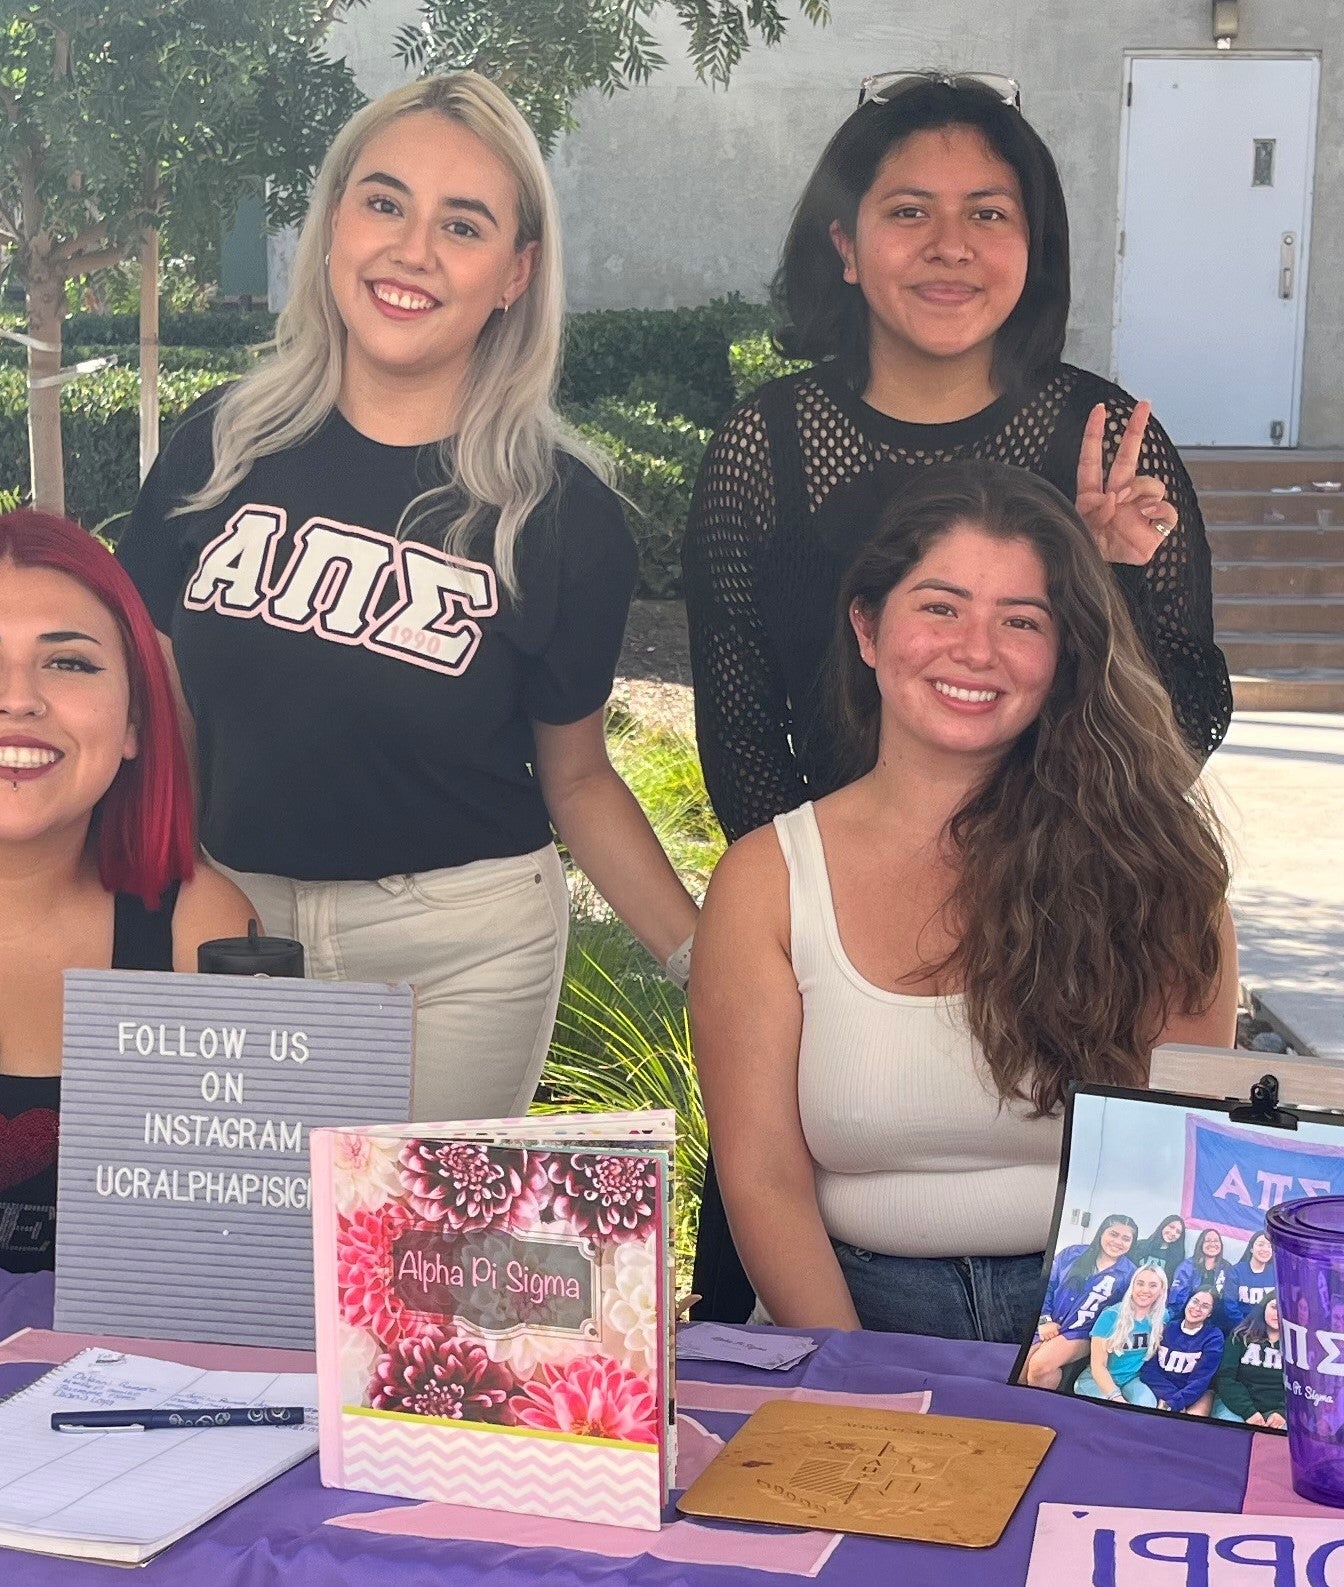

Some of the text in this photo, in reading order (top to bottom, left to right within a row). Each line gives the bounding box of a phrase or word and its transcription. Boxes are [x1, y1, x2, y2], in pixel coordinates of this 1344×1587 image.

[389, 623, 443, 656] 1990
[117, 1021, 310, 1064] FOLLOW US
[201, 1070, 244, 1104] ON
[143, 1112, 303, 1153] INSTAGRAM
[96, 1164, 312, 1211] UCRALPHAPISIG
[398, 1250, 580, 1304] Alpha Pi Sigma
